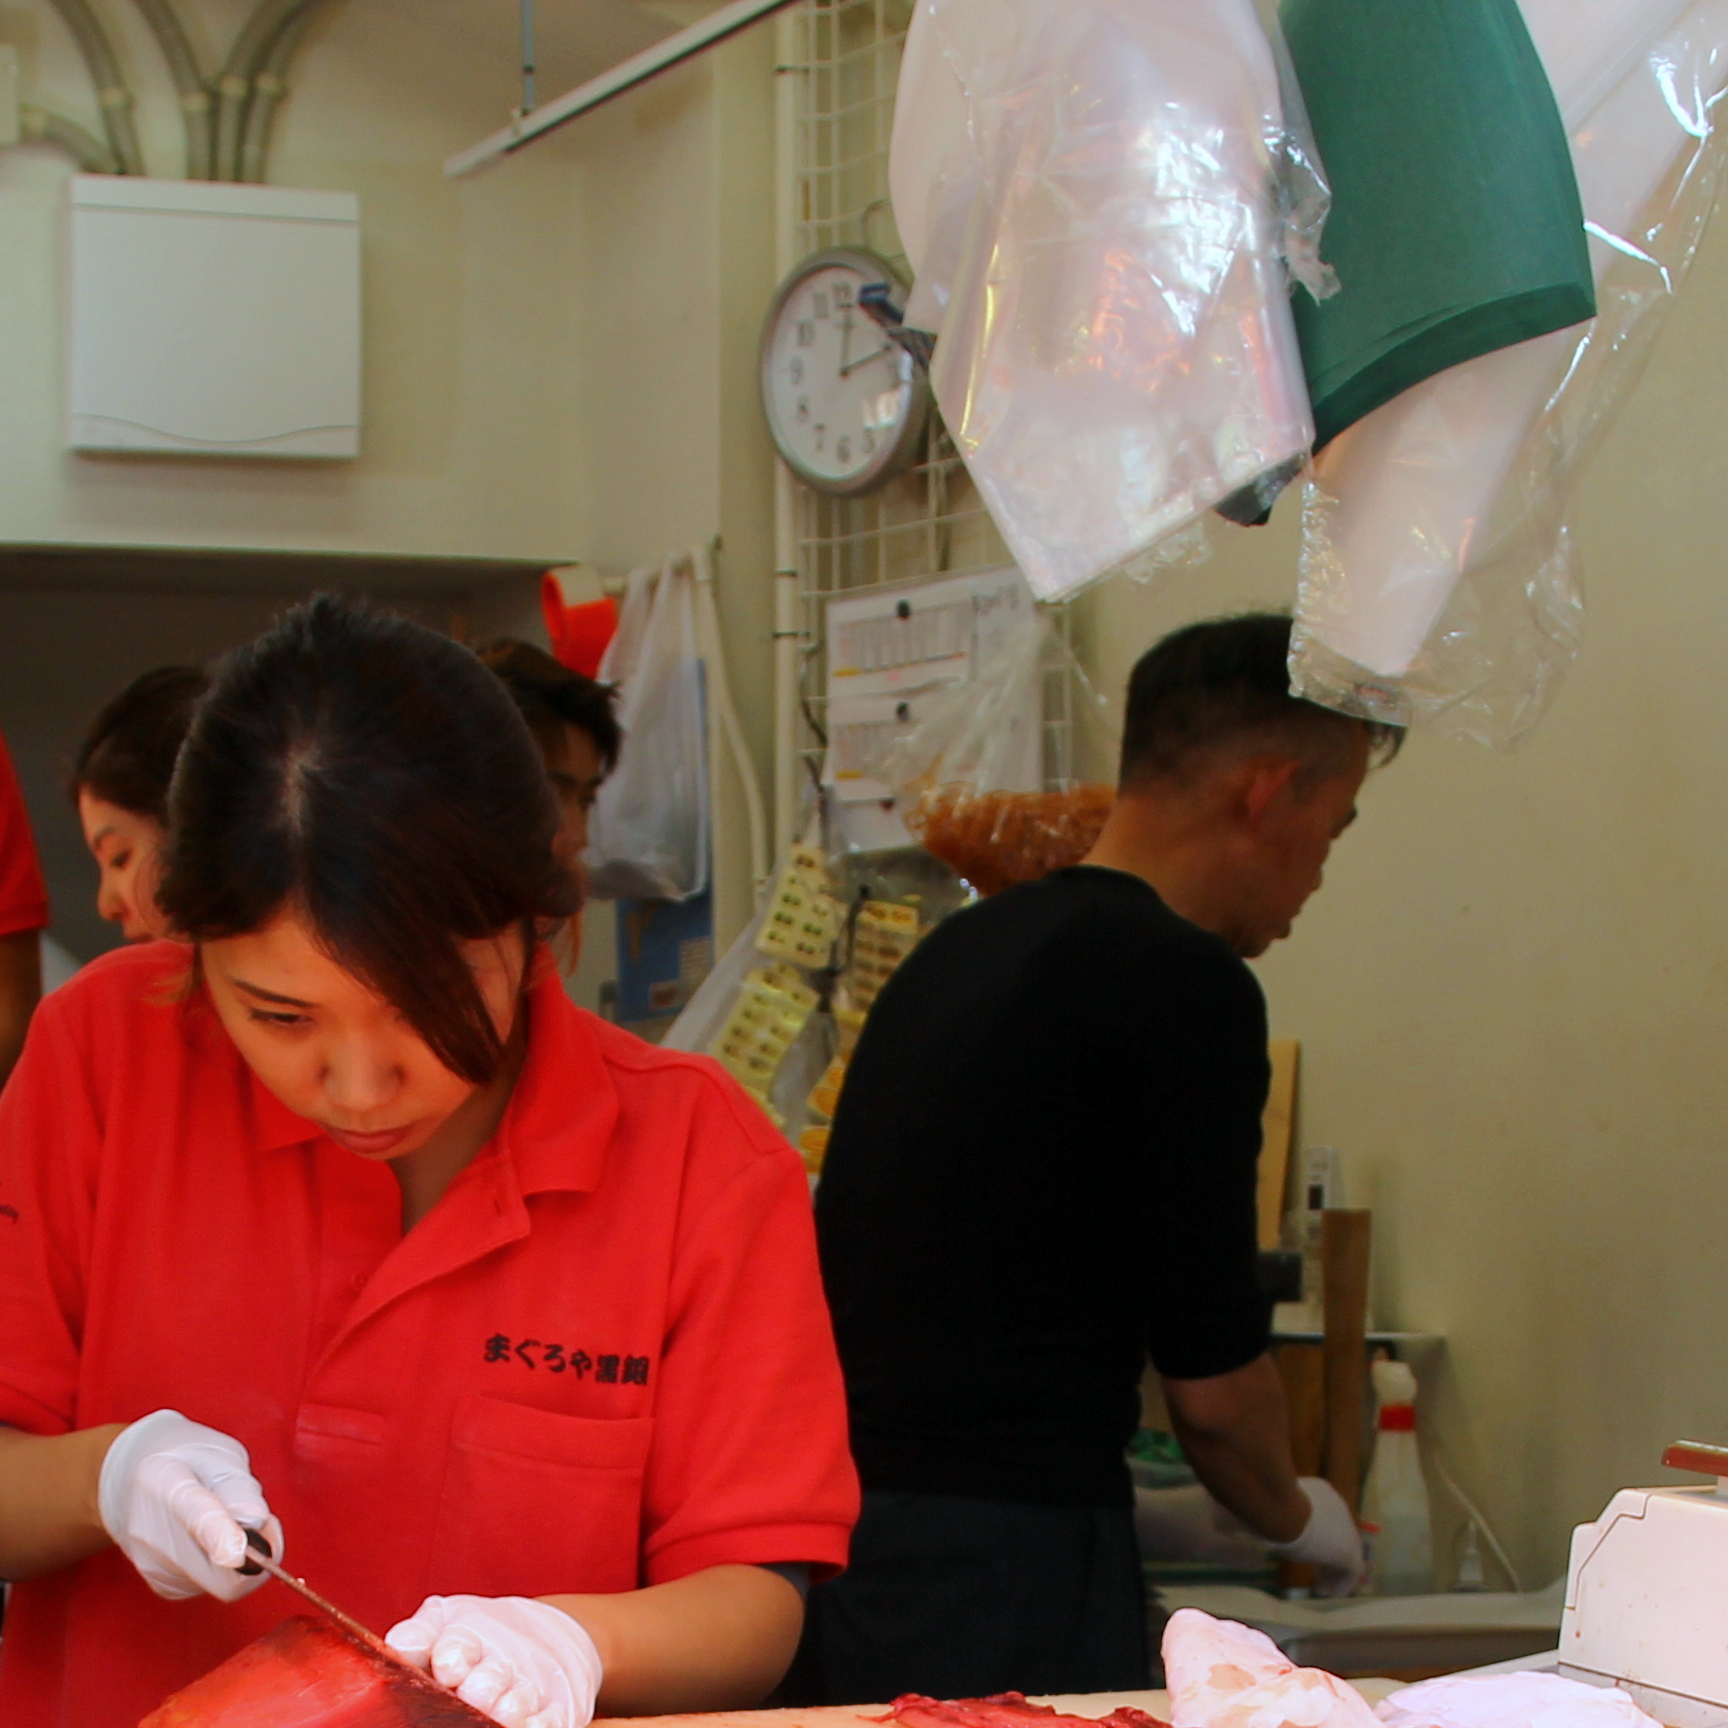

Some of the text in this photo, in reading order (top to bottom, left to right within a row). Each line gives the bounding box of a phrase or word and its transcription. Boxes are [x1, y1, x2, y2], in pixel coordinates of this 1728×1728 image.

[484, 1333, 650, 1386] まぐろや黒銀
